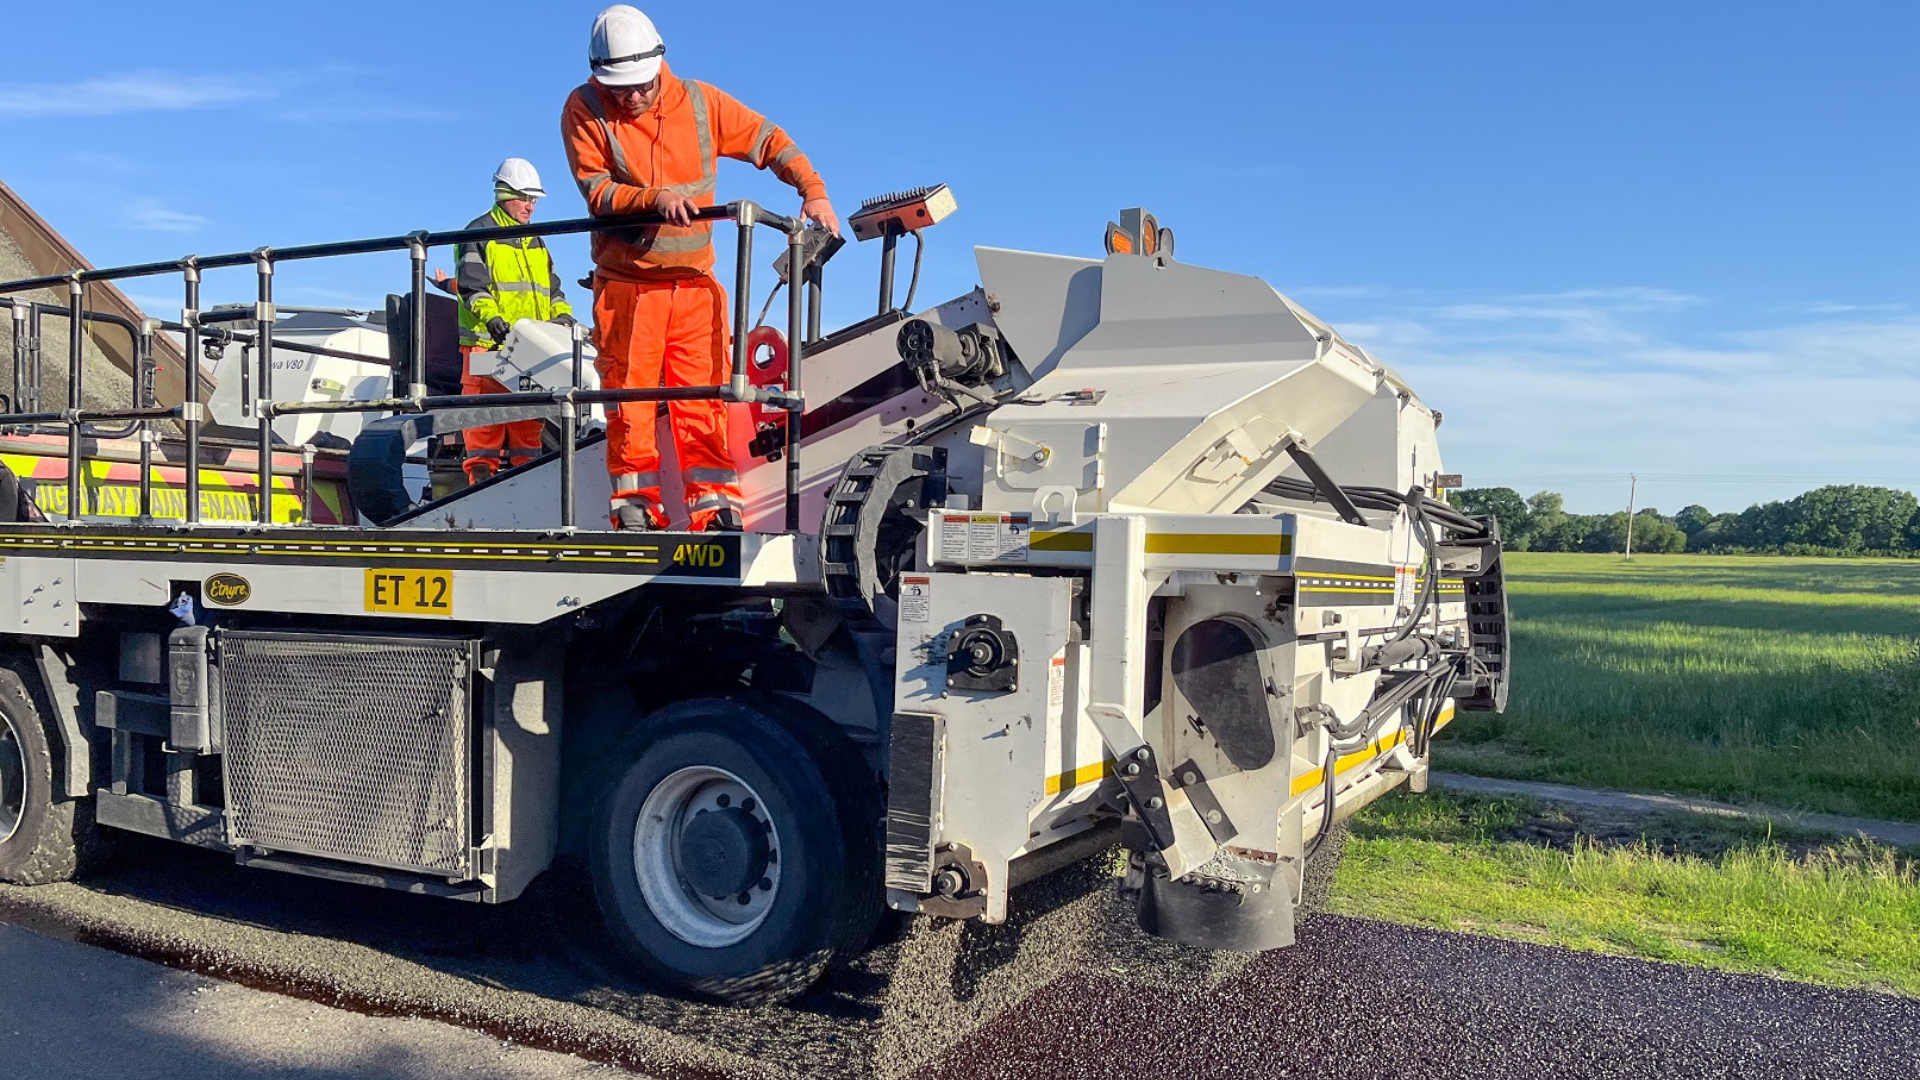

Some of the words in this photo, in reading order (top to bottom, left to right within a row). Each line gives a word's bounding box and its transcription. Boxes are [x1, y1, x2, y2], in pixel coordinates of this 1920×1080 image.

[286, 359, 304, 370] V80
[35, 485, 127, 514] HIGAY
[673, 544, 725, 567] 4WD
[211, 580, 246, 600] Etnyre
[374, 574, 405, 606] ET
[415, 576, 447, 608] 12
